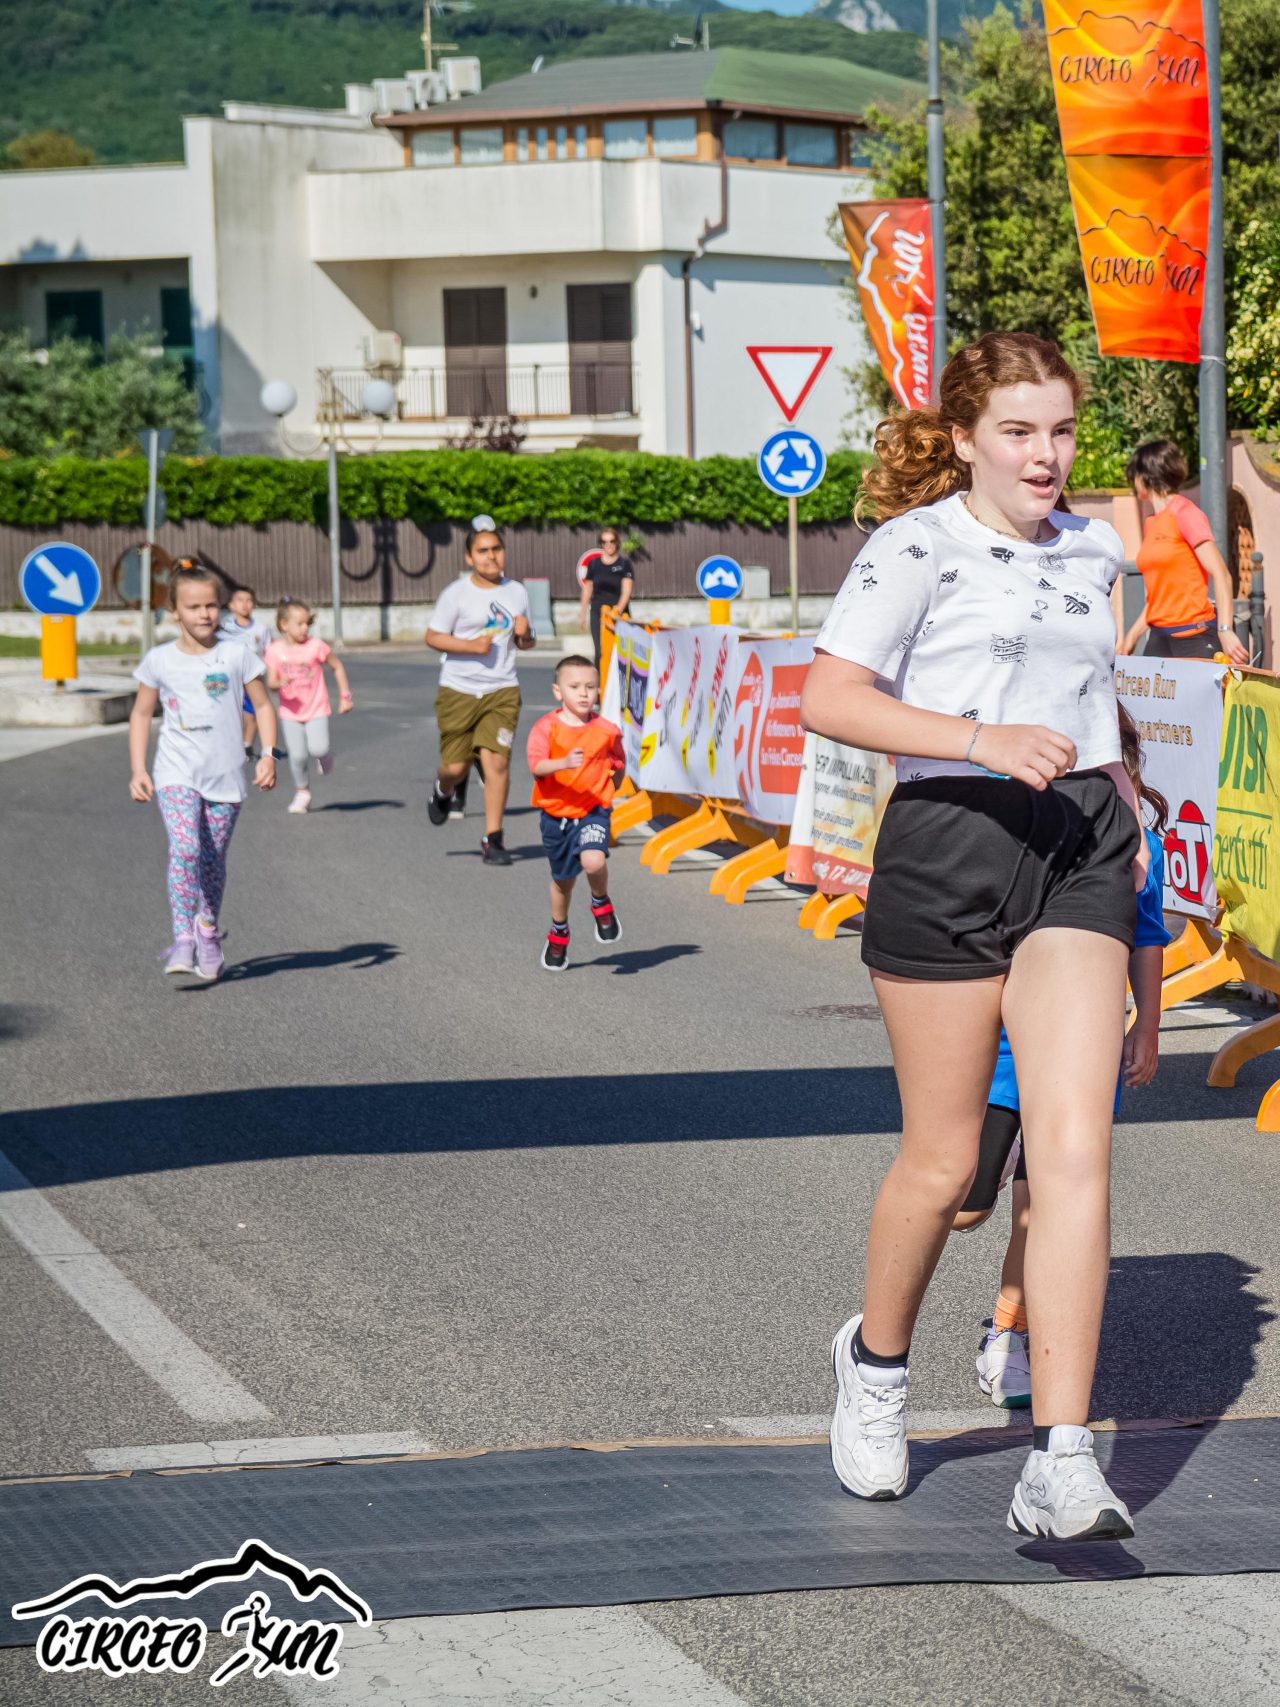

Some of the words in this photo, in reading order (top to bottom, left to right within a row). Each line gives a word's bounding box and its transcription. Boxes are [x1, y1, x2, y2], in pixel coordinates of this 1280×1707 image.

[1114, 669, 1150, 697] Circeo
[1153, 673, 1177, 700] Run
[1138, 719, 1193, 746] partners
